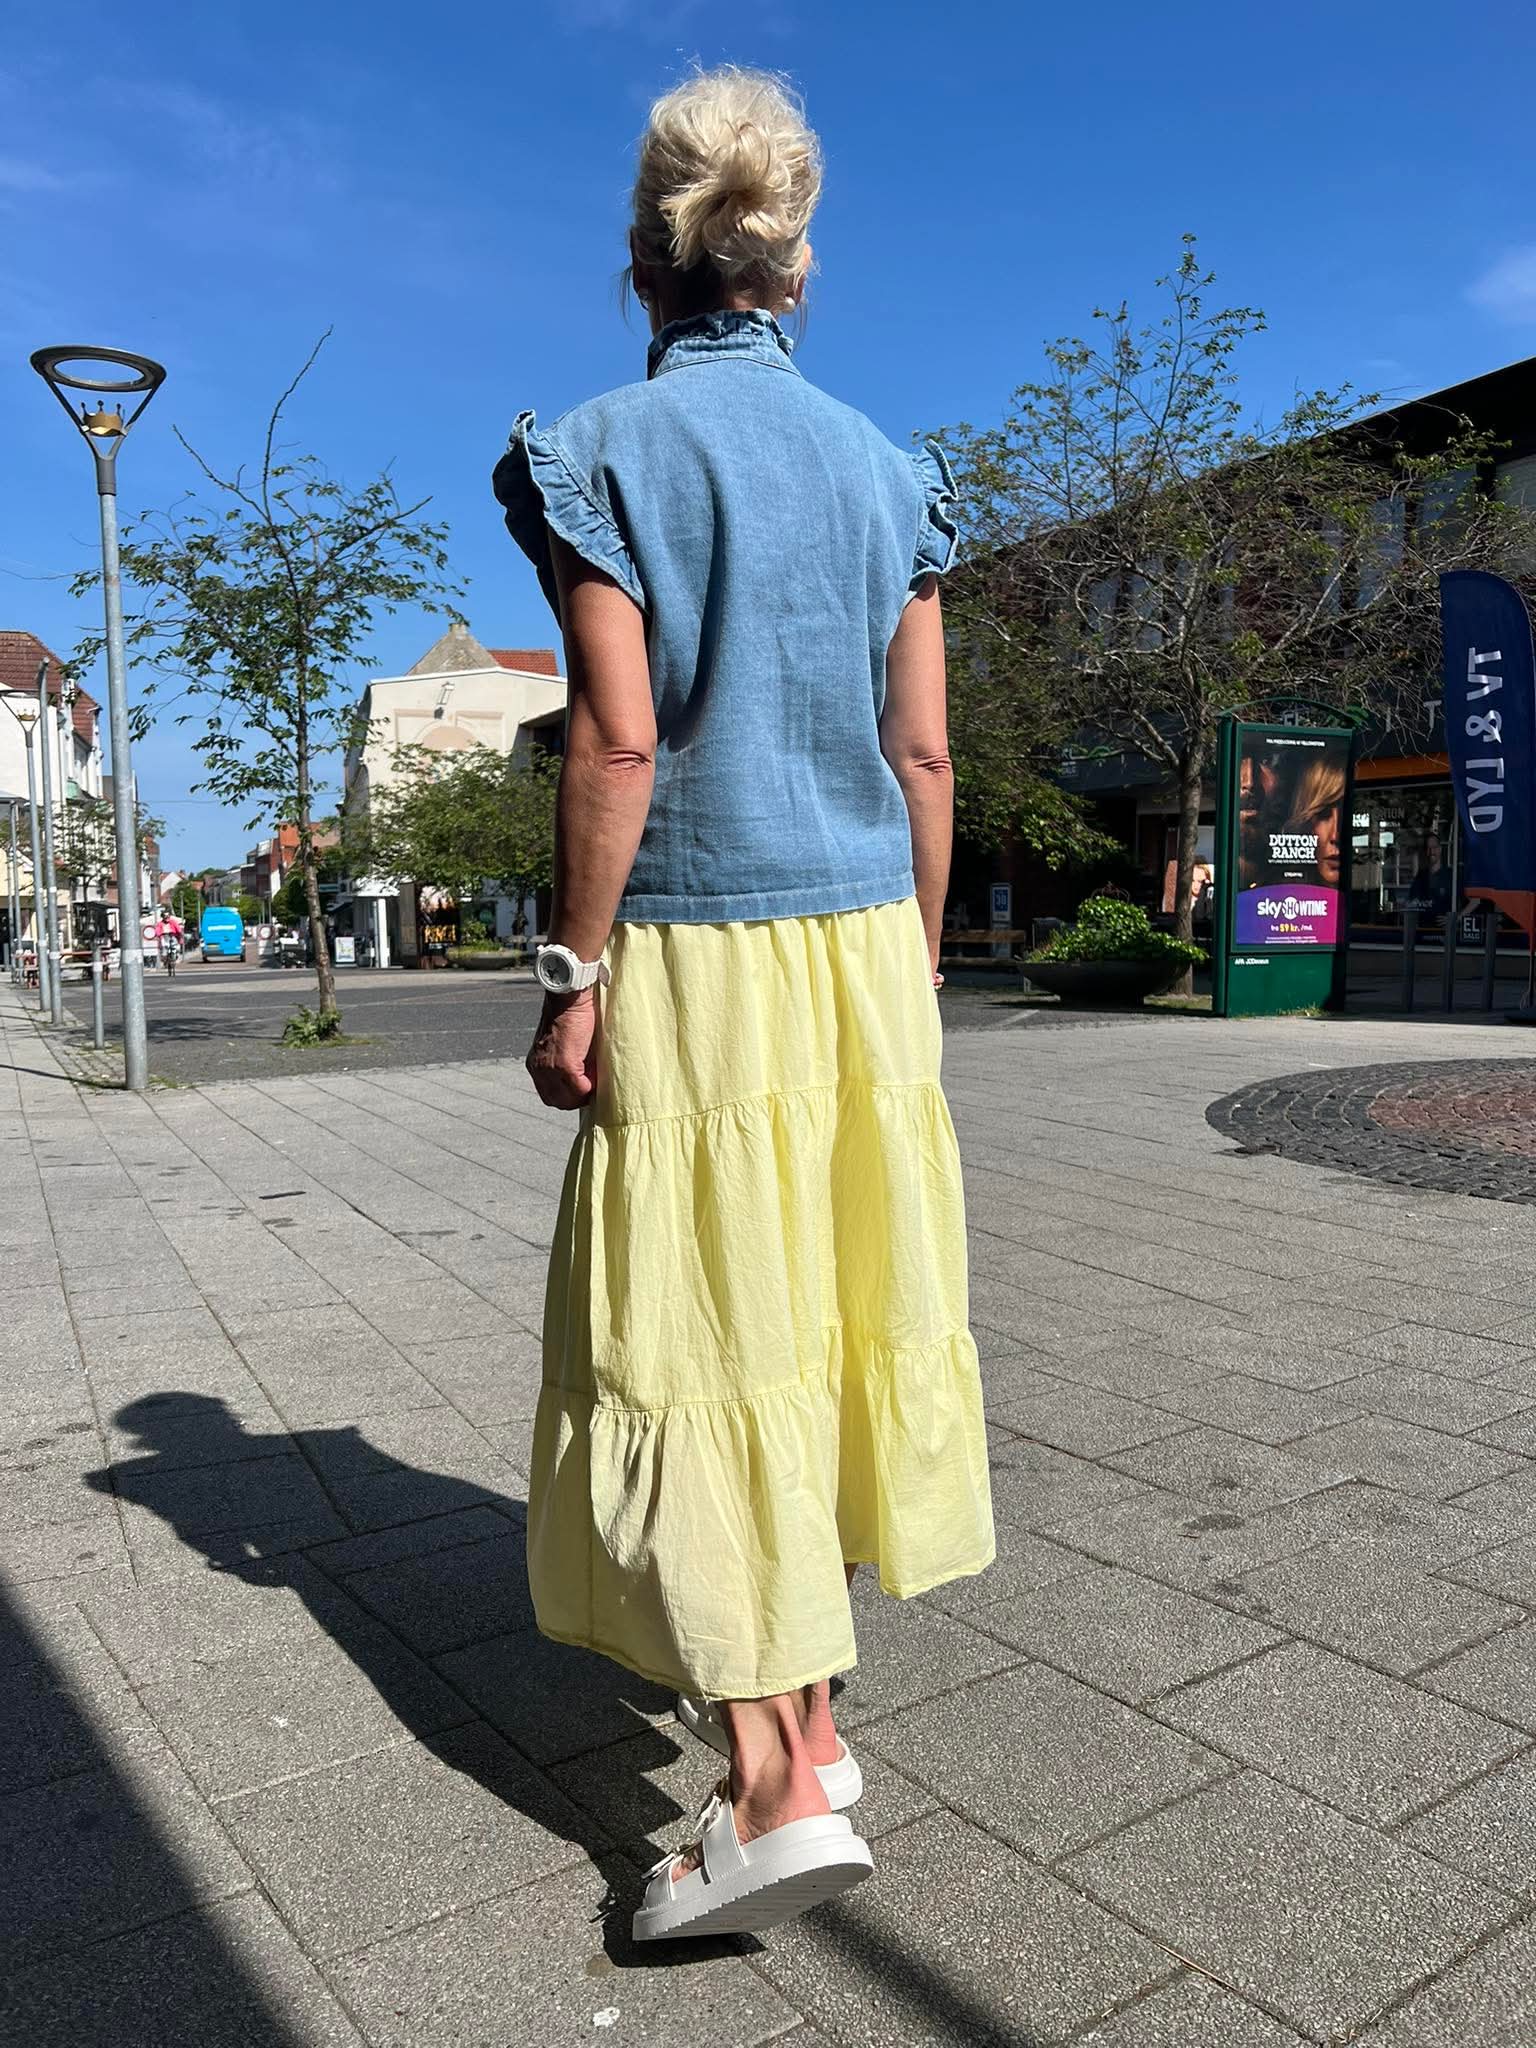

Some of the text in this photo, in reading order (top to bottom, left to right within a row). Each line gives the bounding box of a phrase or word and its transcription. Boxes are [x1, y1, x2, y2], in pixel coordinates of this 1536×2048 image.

[1268, 834, 1319, 847] DUTTON
[1271, 846, 1315, 859] RANCH
[1280, 923, 1289, 932] 59
[1463, 917, 1480, 932] EL
